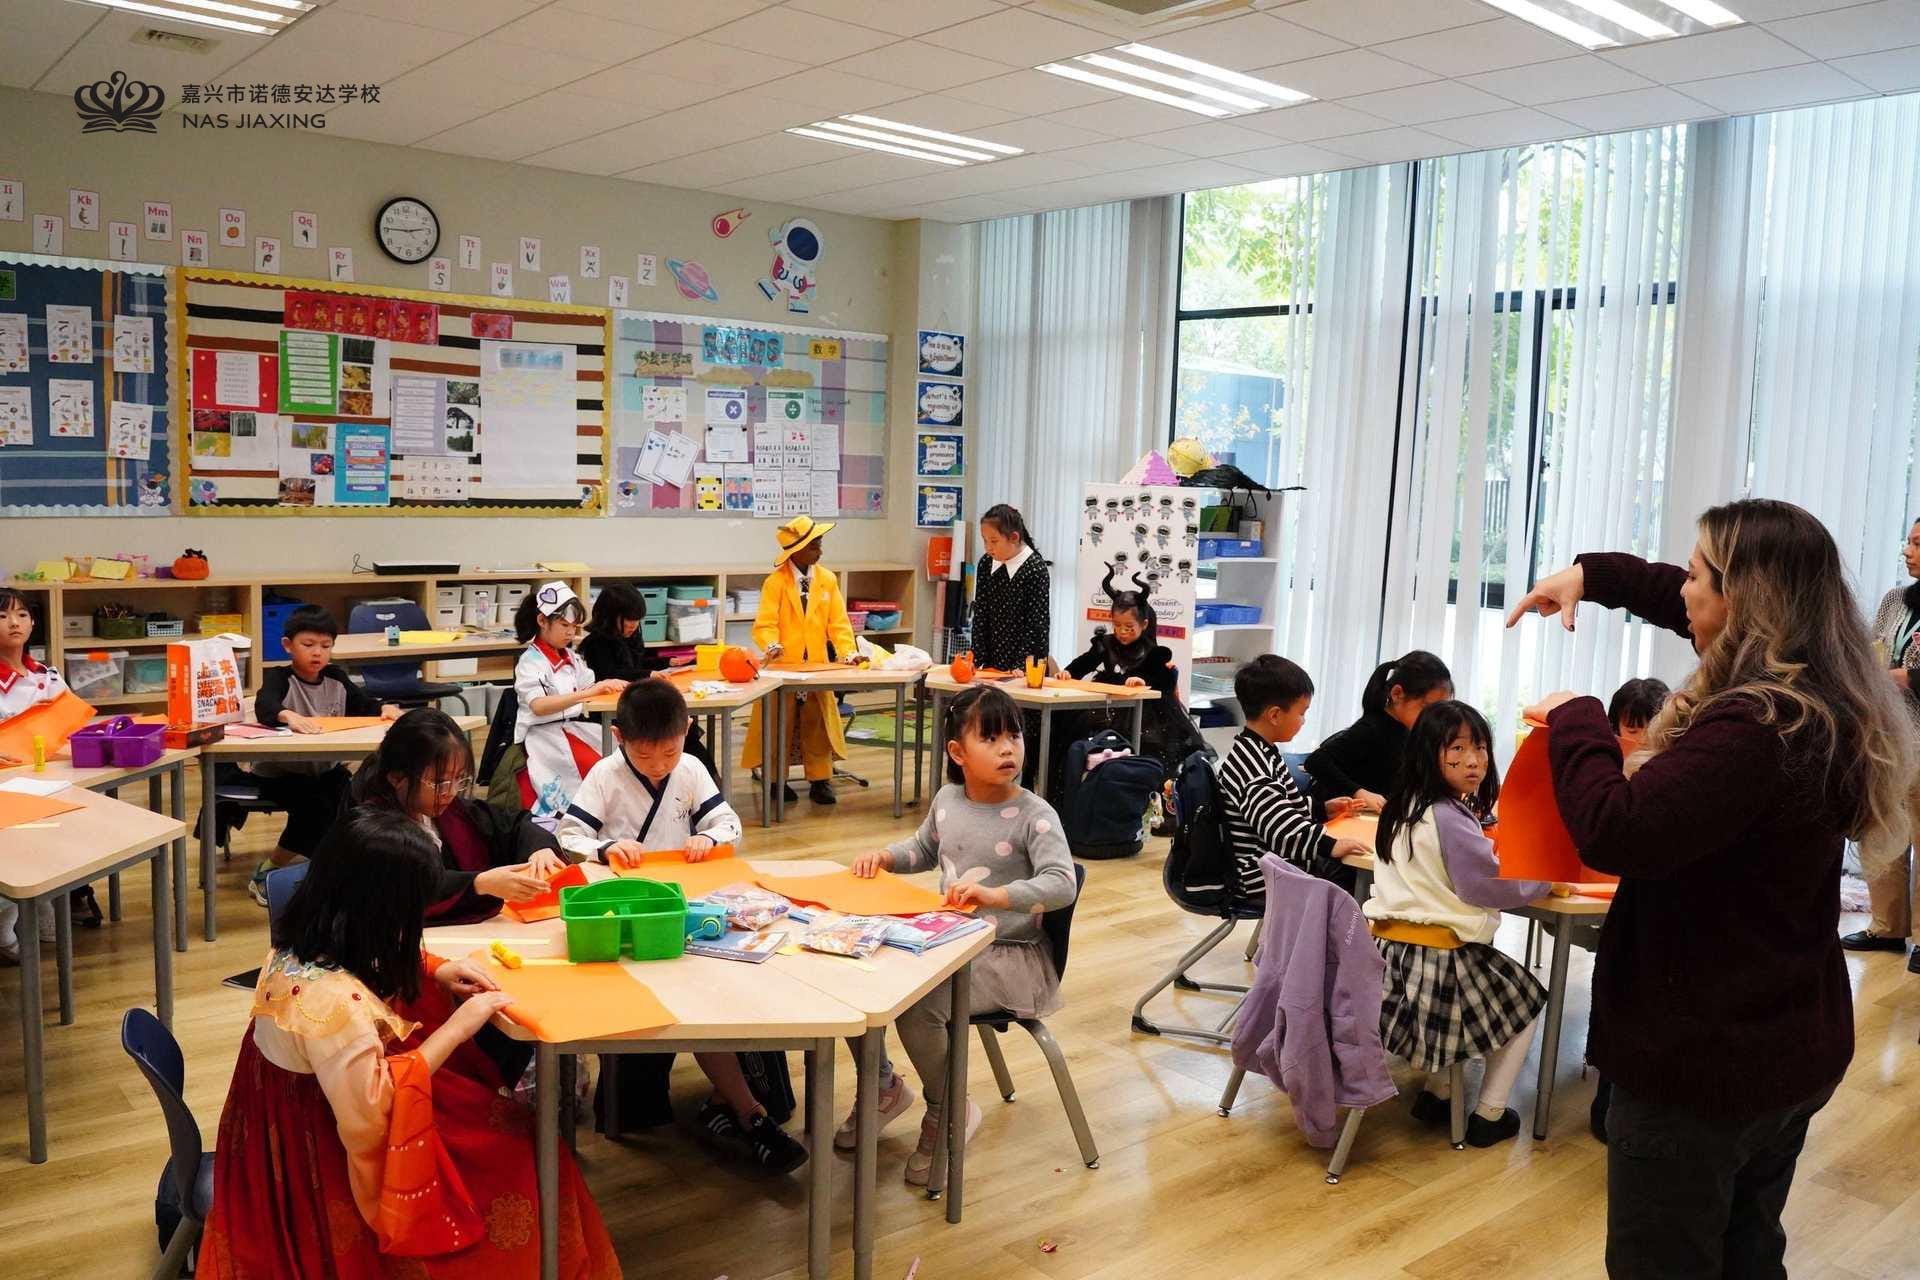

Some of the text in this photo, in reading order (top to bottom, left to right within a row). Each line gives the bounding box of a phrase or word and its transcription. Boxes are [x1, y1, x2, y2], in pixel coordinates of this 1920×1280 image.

[147, 206, 168, 217] Mm
[225, 213, 241, 223] Oo
[186, 234, 203, 245] Nn
[261, 241, 275, 253] Pp
[550, 279, 568, 288] Ww
[1152, 600, 1177, 608] Absent
